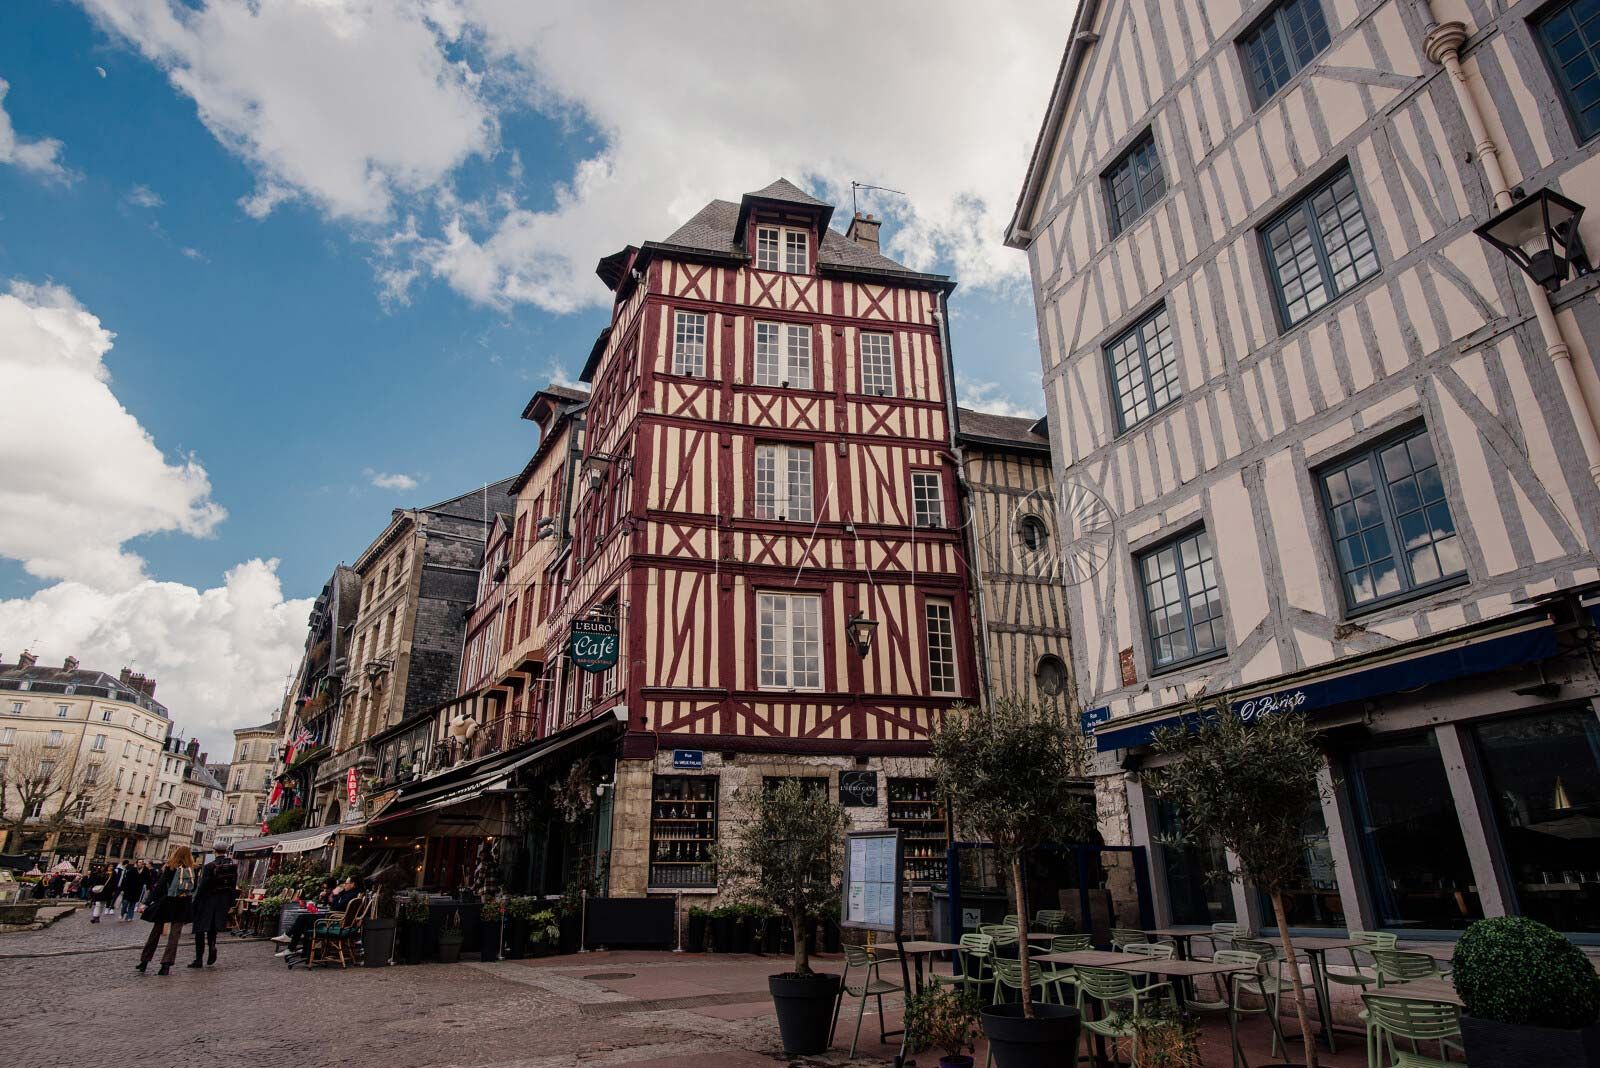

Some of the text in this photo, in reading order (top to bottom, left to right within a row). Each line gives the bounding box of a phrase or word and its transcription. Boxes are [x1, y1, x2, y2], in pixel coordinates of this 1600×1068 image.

[575, 622, 612, 632] L'EURO
[573, 635, 615, 667] Café
[348, 768, 357, 803] TABAC
